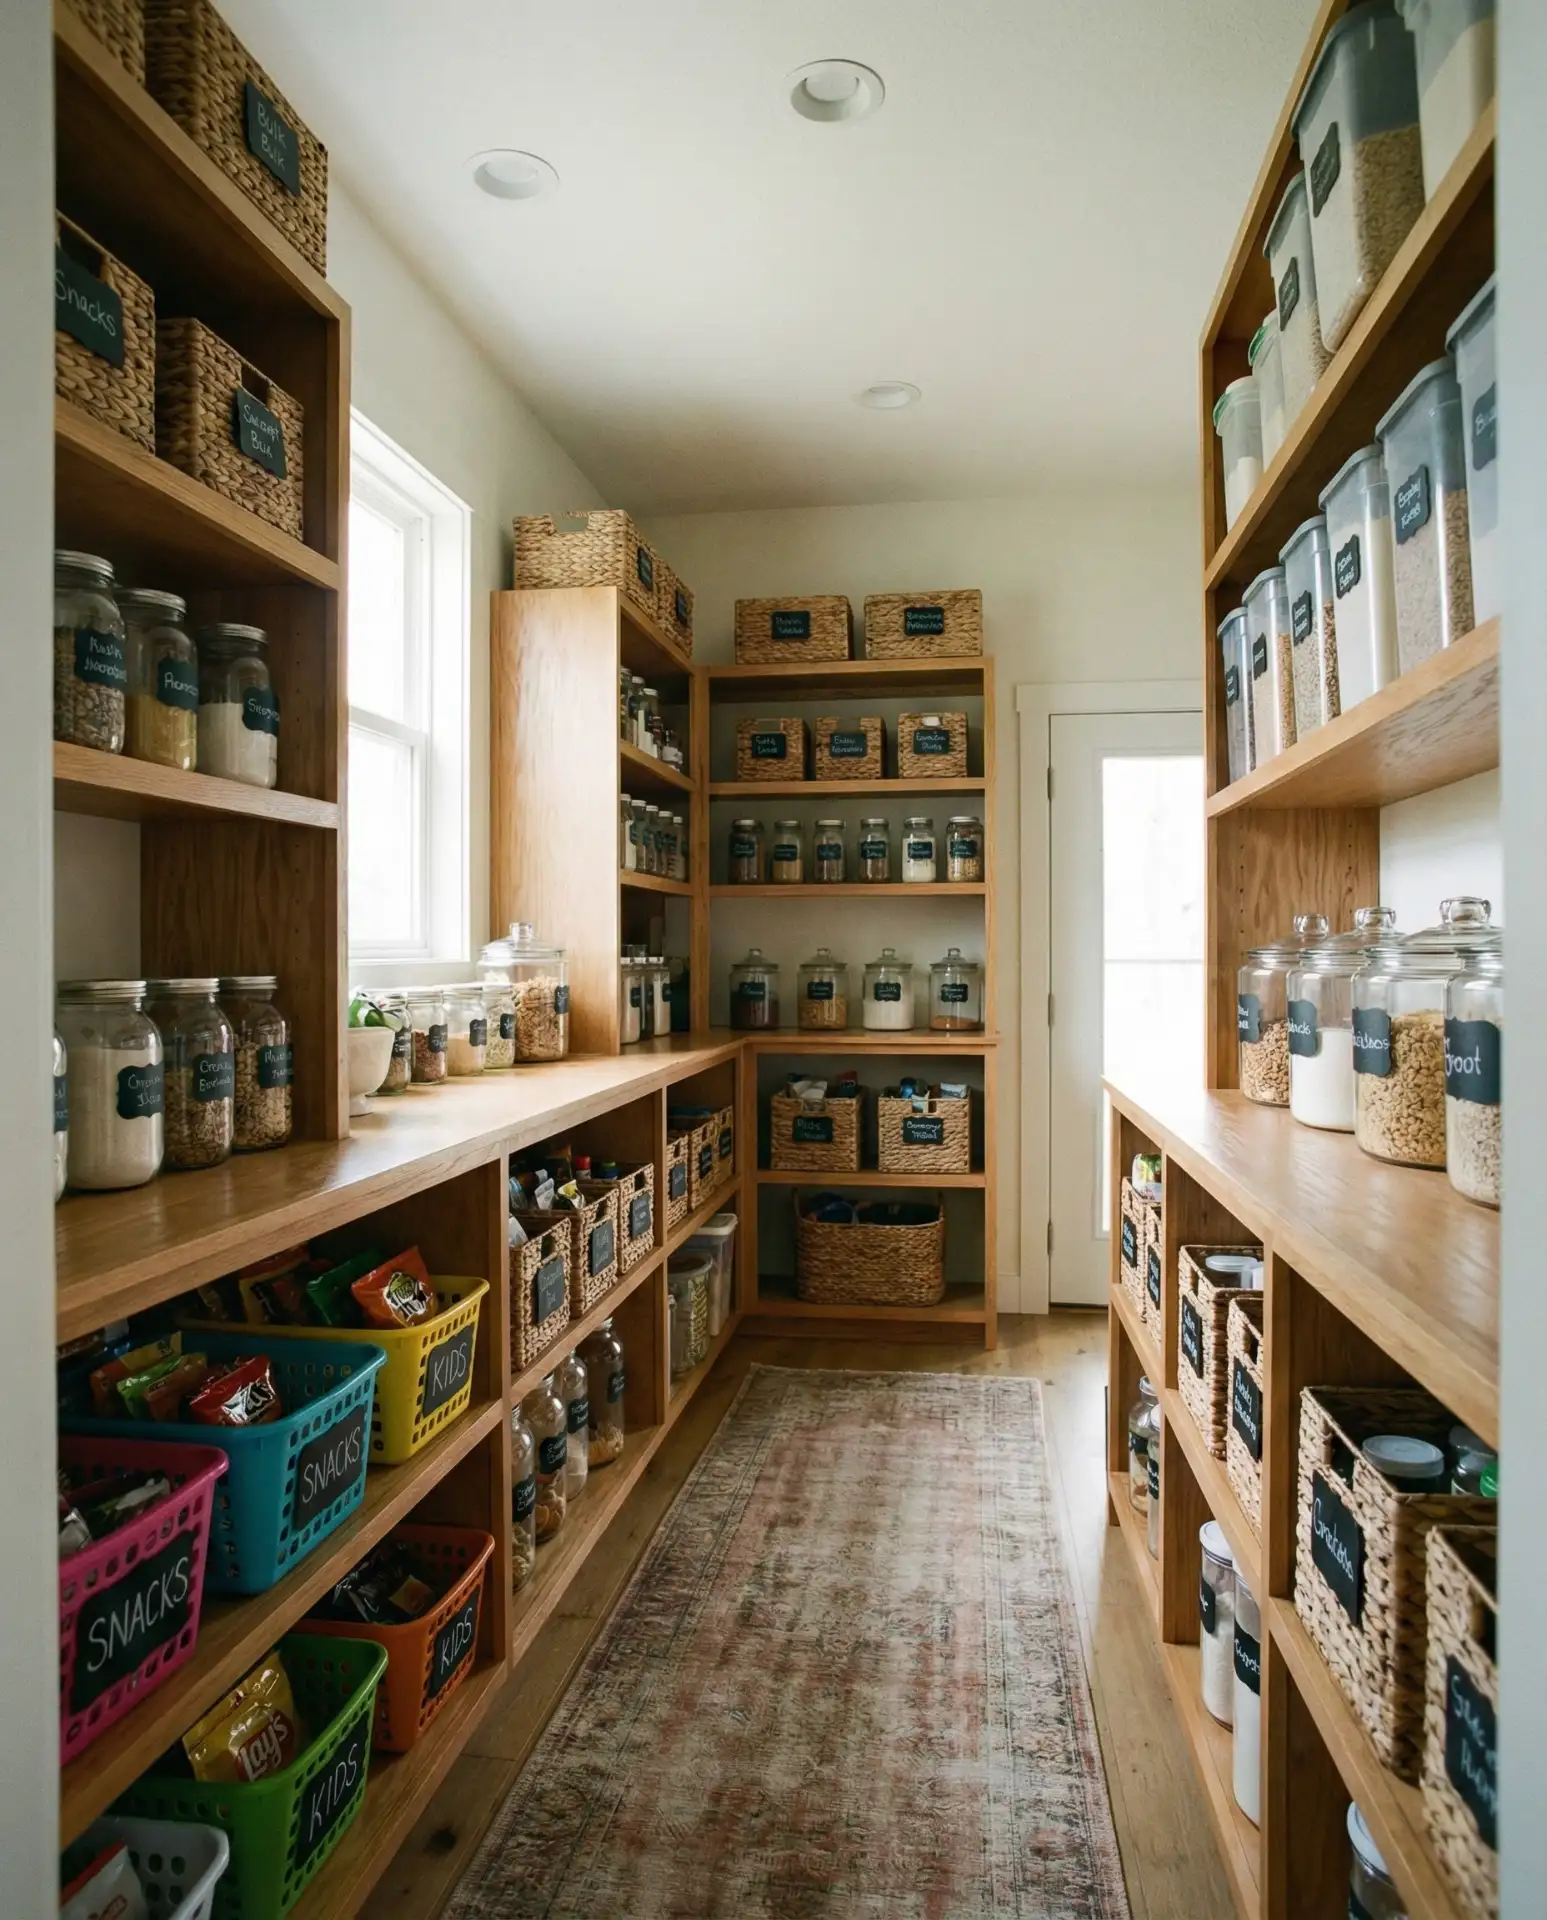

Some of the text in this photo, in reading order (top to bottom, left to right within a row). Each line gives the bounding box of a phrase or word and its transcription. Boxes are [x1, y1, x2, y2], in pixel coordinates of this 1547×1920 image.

[258, 102, 287, 149] Bulk
[261, 132, 285, 172] Bulk
[56, 269, 116, 337] Snacks
[432, 1342, 467, 1397] KIDS
[302, 1426, 361, 1504] SNACKS
[87, 1556, 189, 1673] SNACKS
[440, 1607, 473, 1675] KIDS
[237, 1714, 289, 1782] Lay's
[308, 1743, 357, 1843] KIDS
